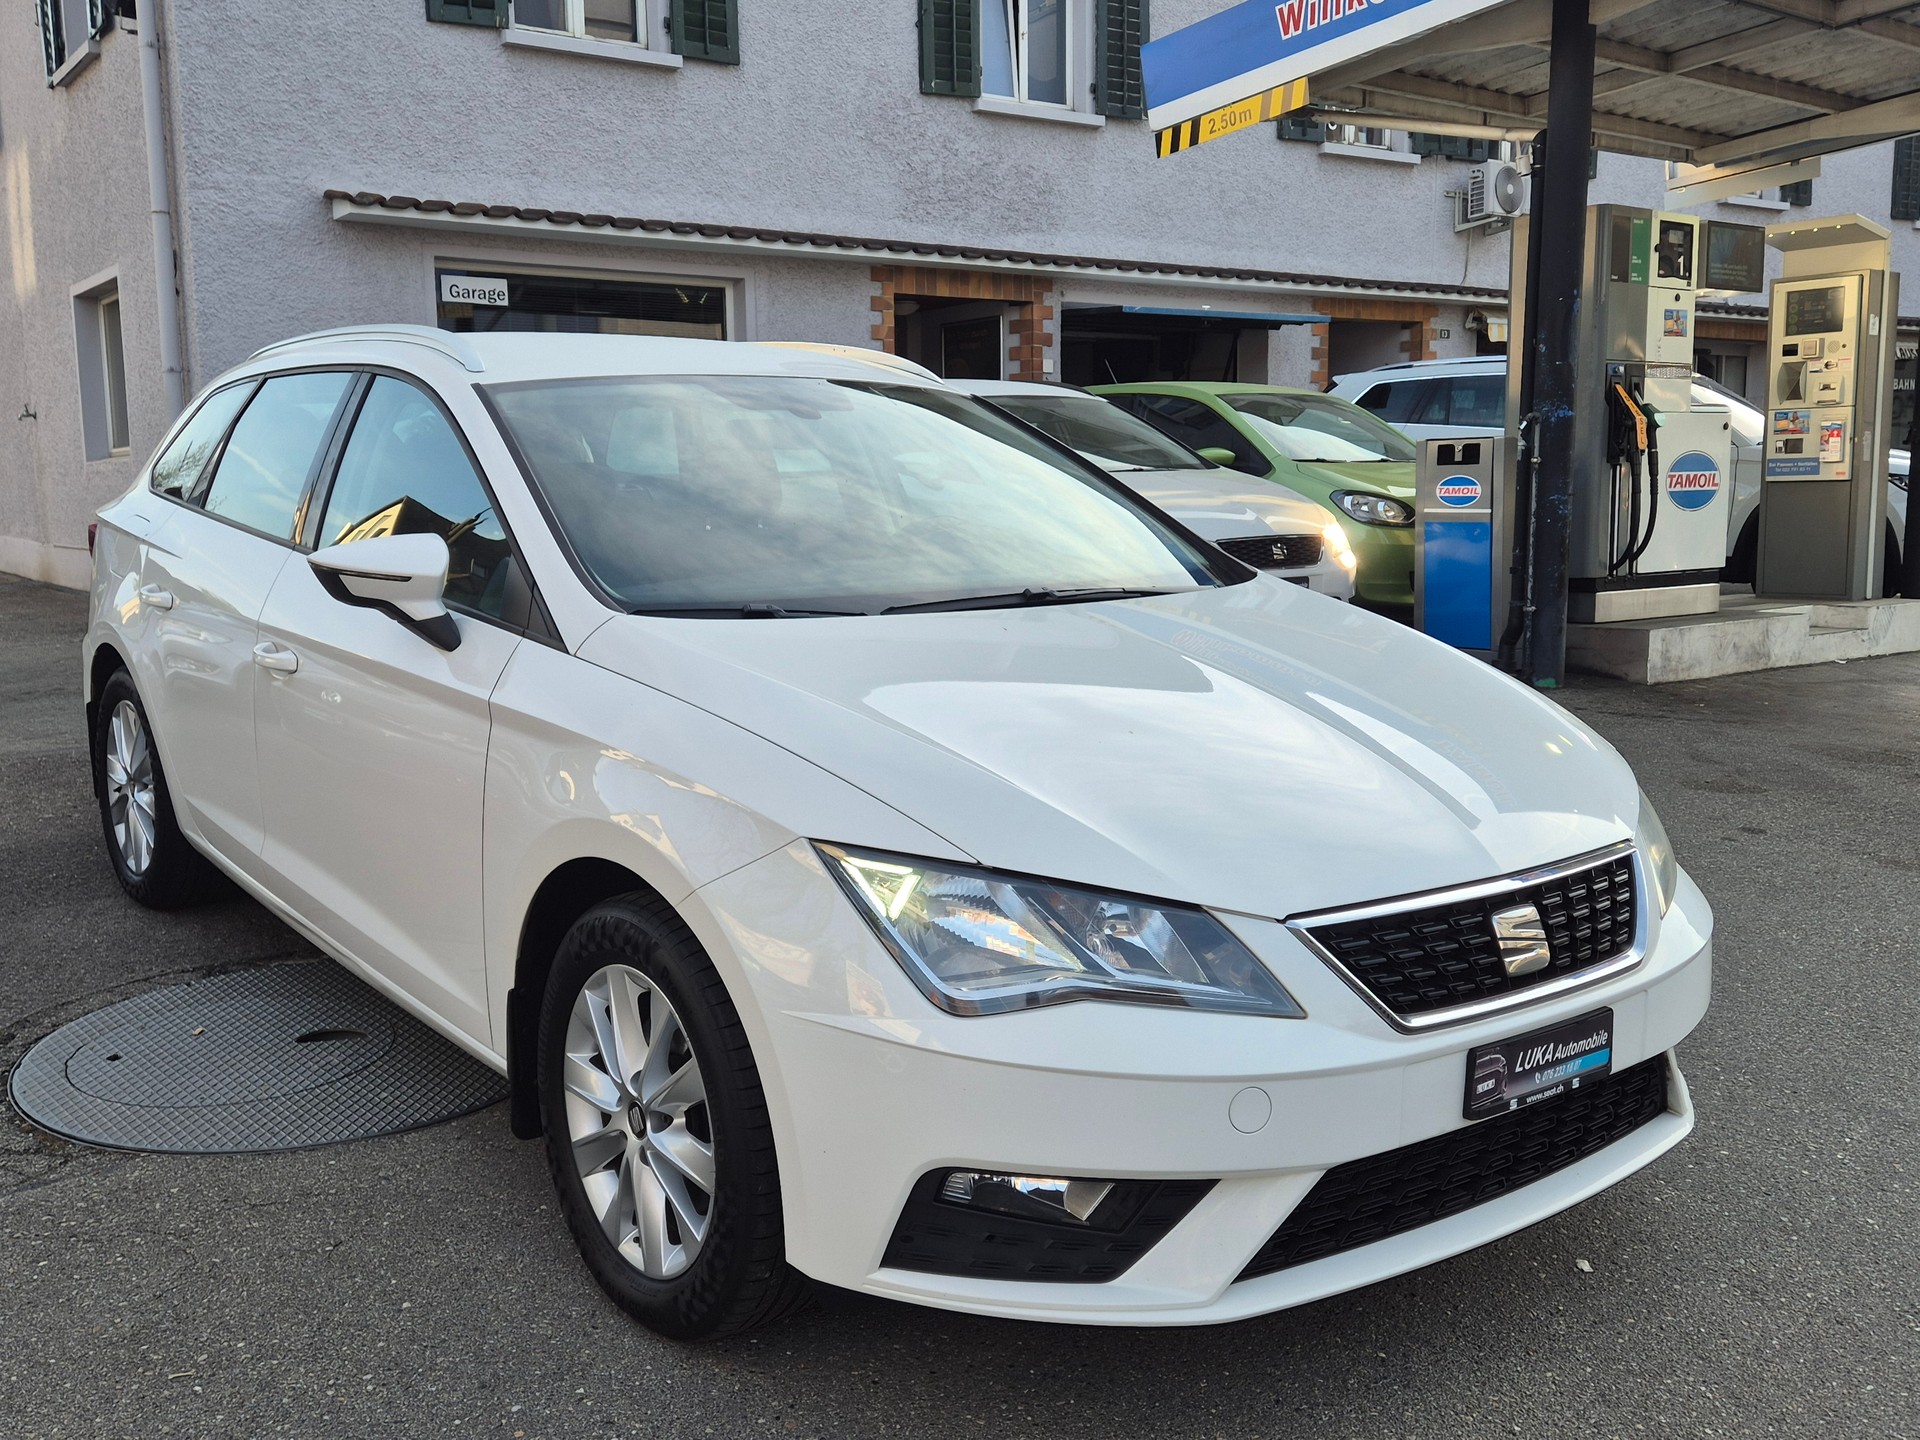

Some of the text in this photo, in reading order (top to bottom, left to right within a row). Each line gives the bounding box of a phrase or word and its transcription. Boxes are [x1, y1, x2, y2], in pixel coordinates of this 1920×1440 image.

[1275, 0, 1385, 40] Will
[1677, 255, 1684, 276] 1
[449, 283, 506, 304] Garage
[1893, 378, 1916, 391] BAHN
[1667, 473, 1719, 489] TAMOIL
[1438, 487, 1480, 496] TAMOIL
[1515, 1029, 1608, 1073] LUKA Automobile
[1526, 1084, 1564, 1104] www.seat.ch
